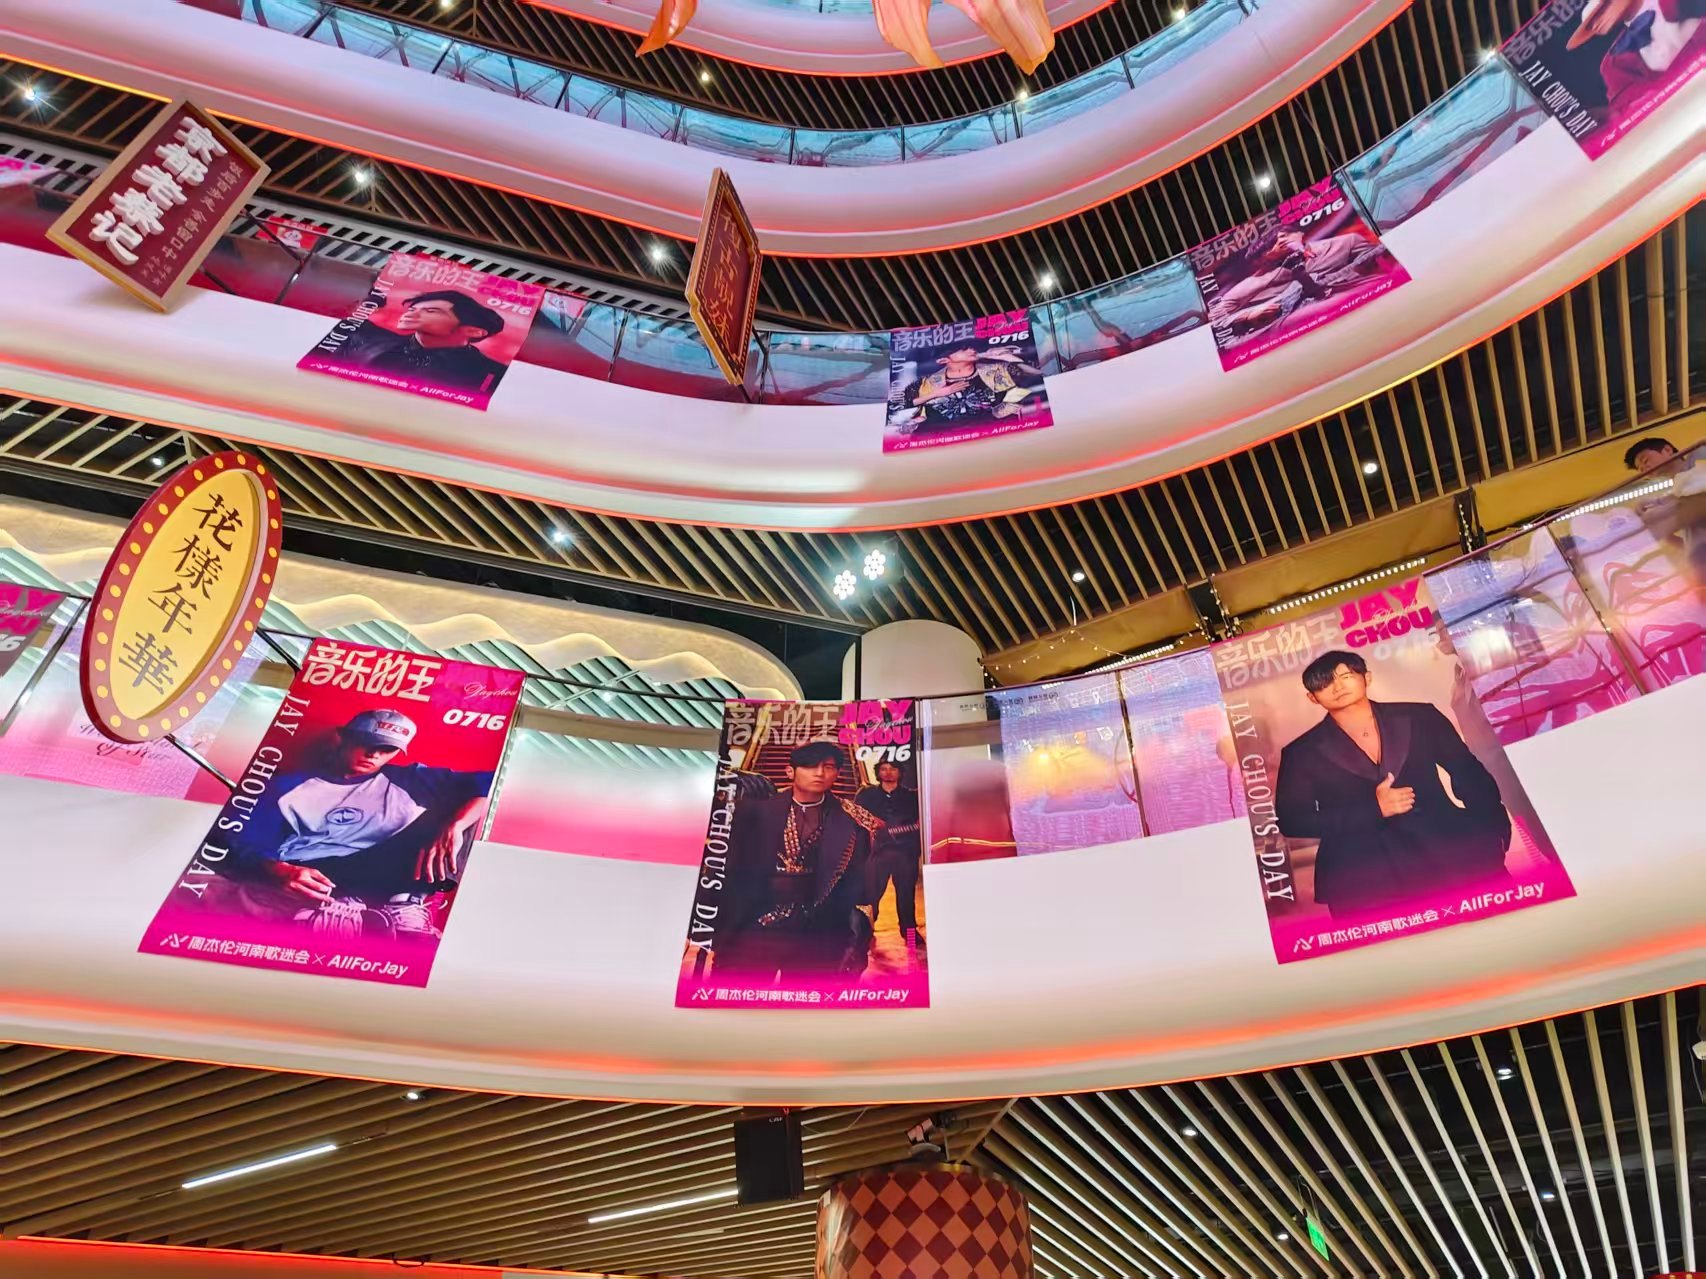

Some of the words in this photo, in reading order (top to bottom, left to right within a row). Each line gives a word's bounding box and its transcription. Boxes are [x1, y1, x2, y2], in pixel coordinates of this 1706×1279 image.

[1518, 60, 1552, 87] JAY
[1542, 81, 1579, 118] CHOU'S
[1566, 110, 1598, 138] DAY
[89, 116, 228, 266] 京都老蔡记
[1300, 198, 1344, 226] 0716
[1191, 211, 1277, 270] 音乐的王
[371, 277, 394, 299] JAY
[388, 257, 484, 291] 音乐的王
[1196, 272, 1219, 294] JAY
[339, 301, 378, 331] CHOU'S
[487, 298, 532, 316] 0716
[318, 331, 348, 352] DAY
[893, 322, 975, 352] 音乐的王
[988, 331, 1030, 344] 0716
[420, 386, 474, 403] AllForJay
[118, 493, 243, 695] 花樣年華
[1340, 576, 1420, 631] JAY
[1345, 605, 1435, 648] CHOU
[1217, 611, 1337, 689] 音乐的王
[303, 643, 442, 703] 音乐的王
[274, 690, 311, 736] JAY
[443, 709, 506, 731] 0716
[726, 702, 839, 745] 音乐的王
[838, 700, 913, 724] JAY
[1224, 702, 1257, 739] JAY
[838, 726, 911, 745] CHOU
[856, 744, 912, 762] 0716
[218, 746, 283, 832] CHOU'S
[1241, 754, 1280, 836] CHOU'S
[179, 843, 229, 898] DAY
[700, 809, 734, 890] CHOU'S
[1260, 851, 1294, 901] DAY
[690, 902, 718, 952] DAY
[1317, 909, 1439, 947] 周杰伦河南歌迷会
[1459, 882, 1545, 914] AllForJay
[187, 935, 311, 965] 周杰伦河南歌迷会
[327, 953, 409, 978] AllForJay
[715, 988, 820, 1002] 周杰伦河南歌迷会
[838, 989, 909, 1002] AllForJay
